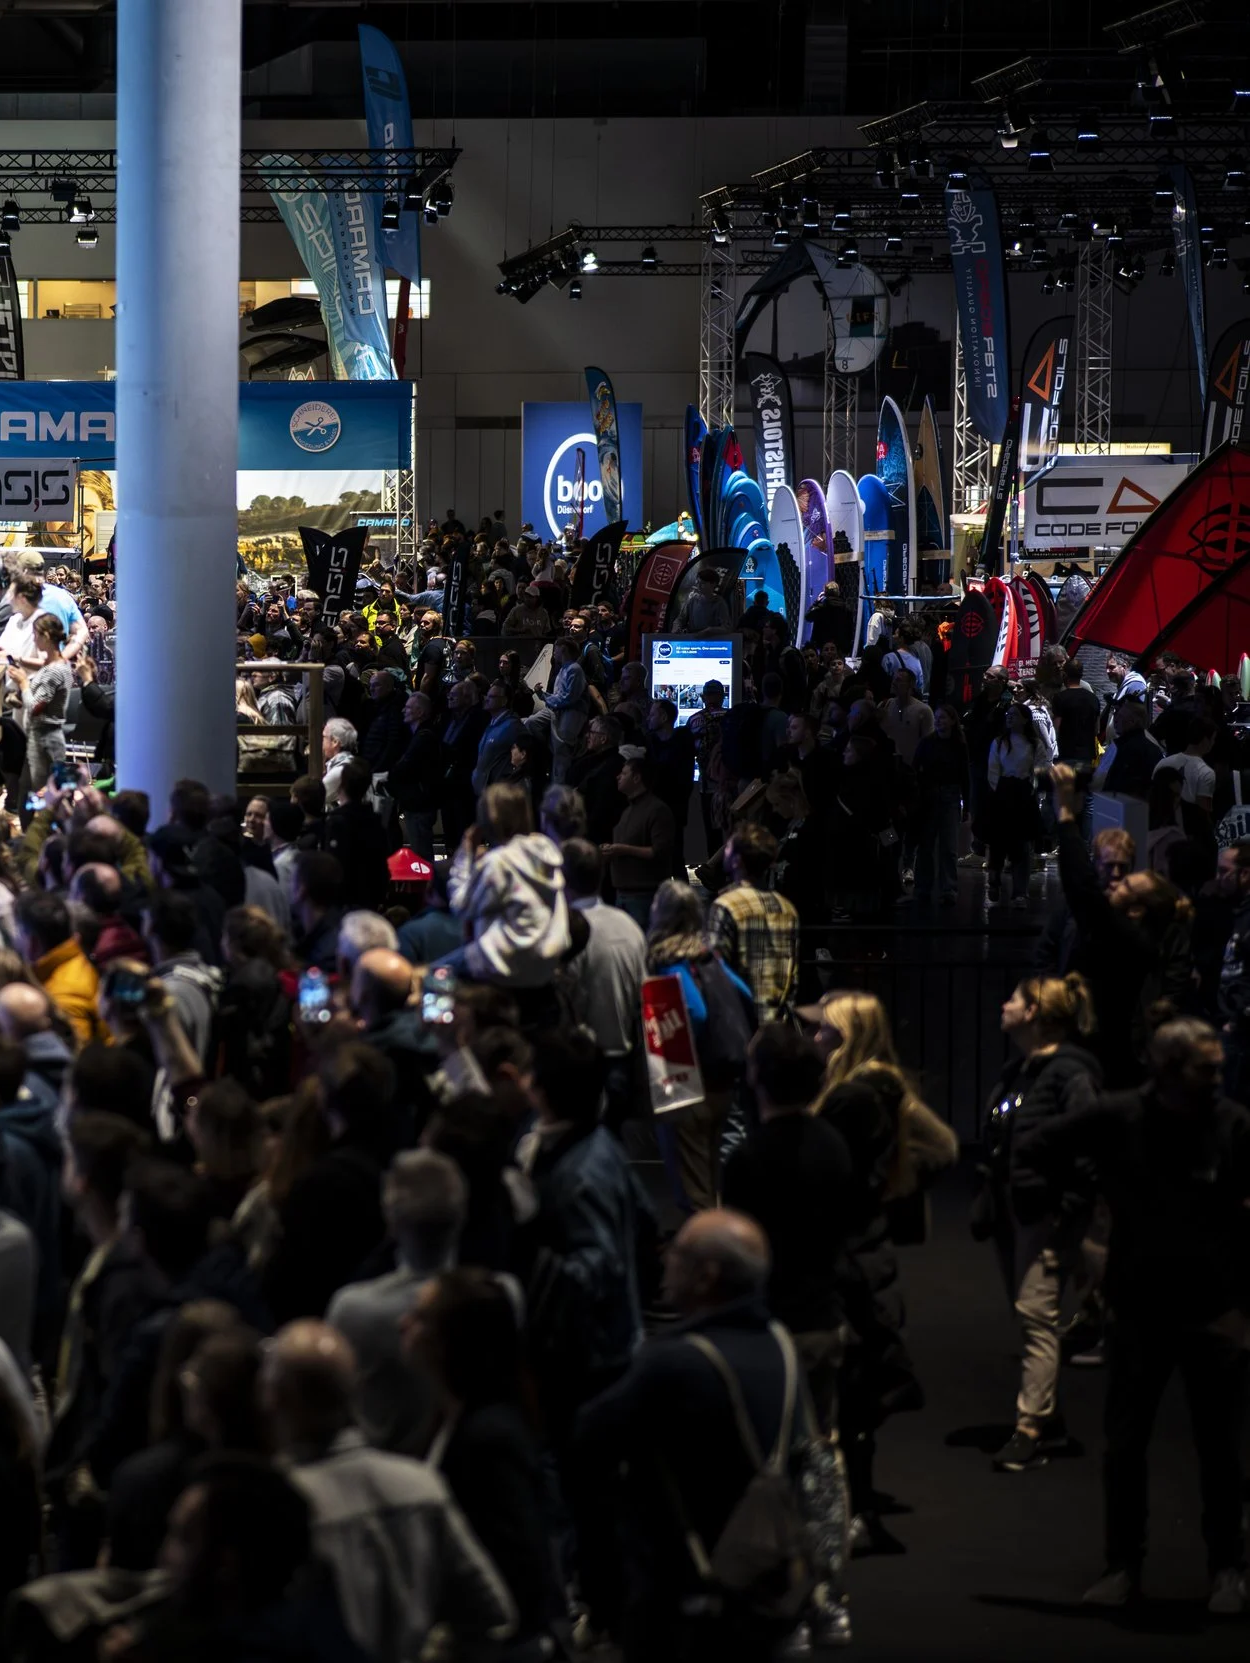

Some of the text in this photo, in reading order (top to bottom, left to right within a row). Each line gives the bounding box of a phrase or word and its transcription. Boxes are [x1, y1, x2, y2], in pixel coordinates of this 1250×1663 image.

[1052, 337, 1069, 407] FOILS
[291, 403, 337, 428] SCHNEIDEREI
[995, 438, 1014, 500] STARBOARD
[557, 475, 605, 502] boo
[357, 518, 412, 527] CAMARO
[1034, 521, 1102, 537] CODE
